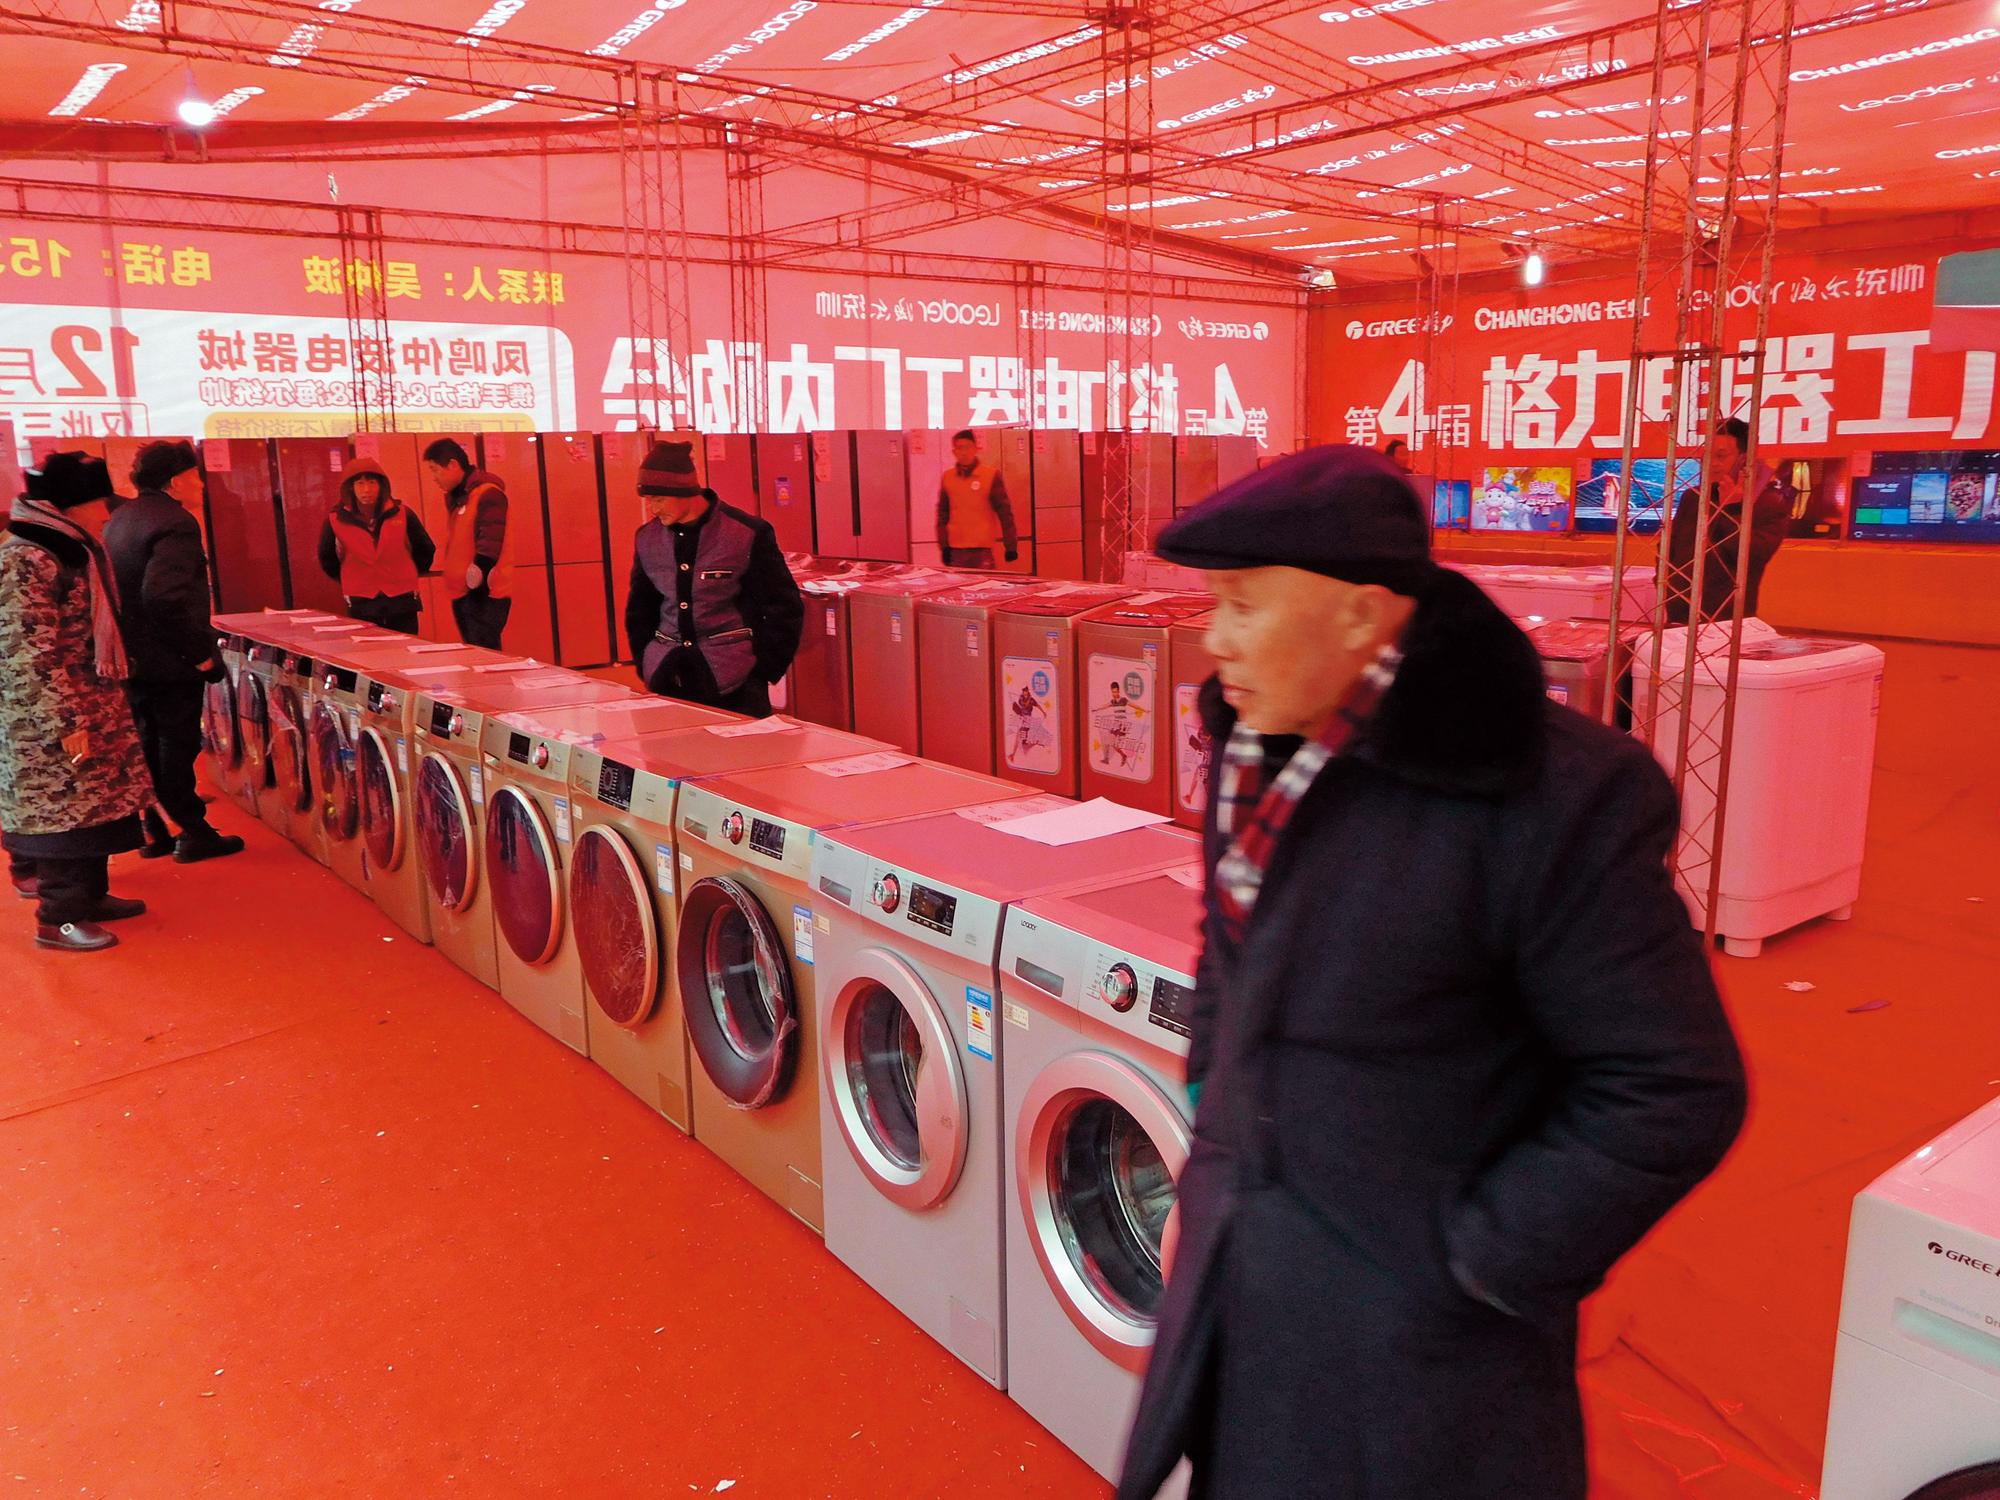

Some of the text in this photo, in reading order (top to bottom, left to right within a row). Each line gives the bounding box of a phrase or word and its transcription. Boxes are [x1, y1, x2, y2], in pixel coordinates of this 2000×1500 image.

[612, 9, 665, 48] GREE
[1346, 24, 1564, 66] CHANGHONG 长虹
[1789, 28, 2000, 82] CHANGHONG
[1061, 72, 1149, 108] Leader
[1838, 77, 1977, 112] Leader
[1180, 98, 1242, 124] GREE
[1564, 101, 1644, 117] GREE
[1366, 317, 1421, 338] GREE
[1474, 300, 1602, 332] CHANGHONG
[1790, 263, 1926, 303] 海尔统帅
[1945, 1249, 1994, 1274] GREE
